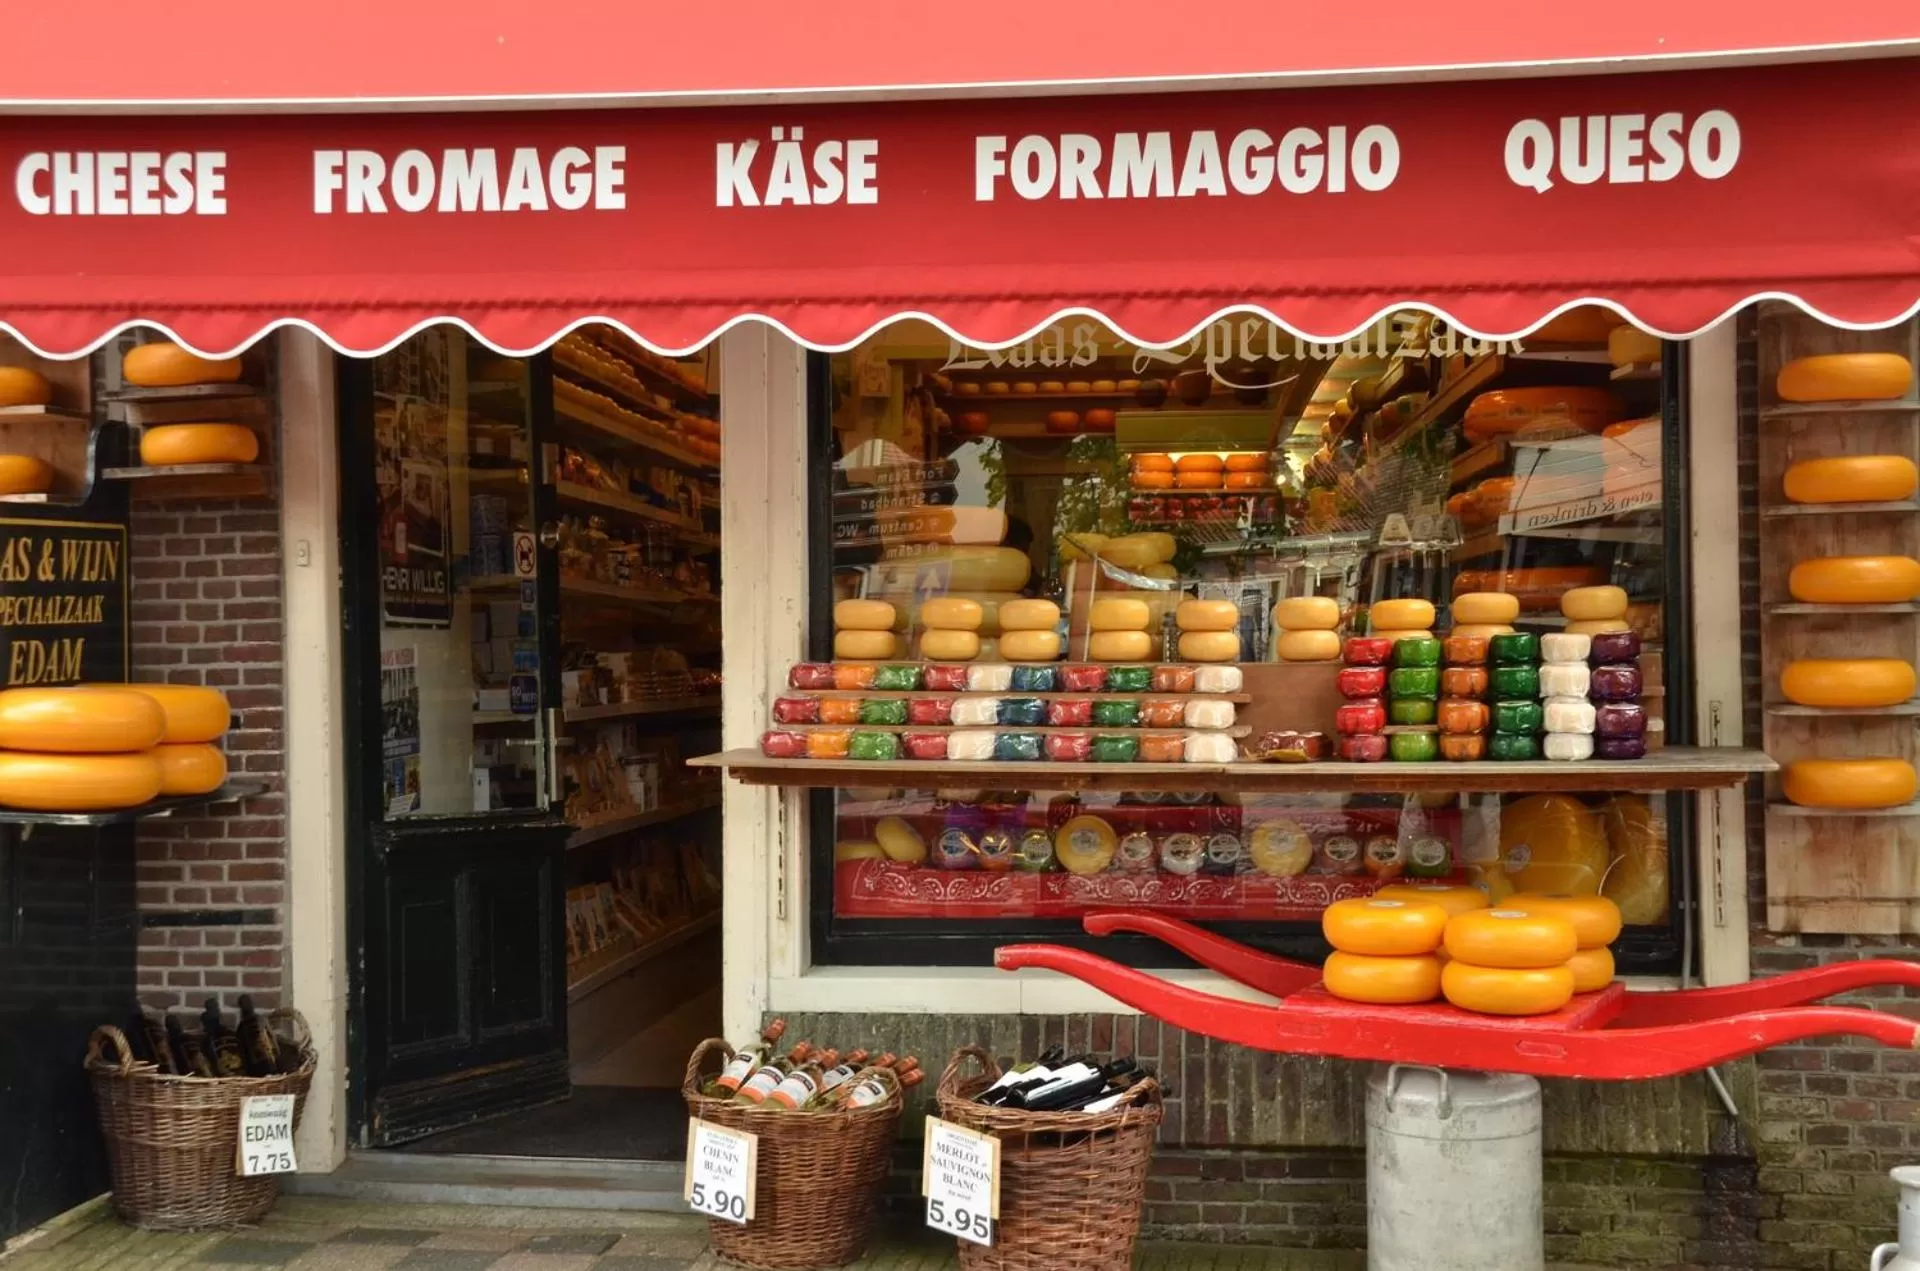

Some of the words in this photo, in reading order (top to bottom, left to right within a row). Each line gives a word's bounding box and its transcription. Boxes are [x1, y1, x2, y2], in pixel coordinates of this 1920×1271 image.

[16, 151, 227, 215] CHEESE
[313, 146, 626, 214] FROMAGE
[716, 126, 878, 207] KÄSE
[975, 125, 1400, 201] FORMAGGIO
[1504, 110, 1741, 194] QUESO
[37, 538, 56, 583] &
[62, 539, 120, 582] WIJN
[8, 638, 85, 686] EDAM
[246, 1123, 288, 1142] EDAM
[248, 1152, 291, 1172] 7.75
[936, 1141, 980, 1165] MERLOT
[704, 1159, 736, 1178] BLANC
[929, 1154, 991, 1184] SAUVIGNON
[942, 1172, 978, 1194] BLANC
[691, 1182, 746, 1219] 5.90
[929, 1198, 989, 1239] 5.95
